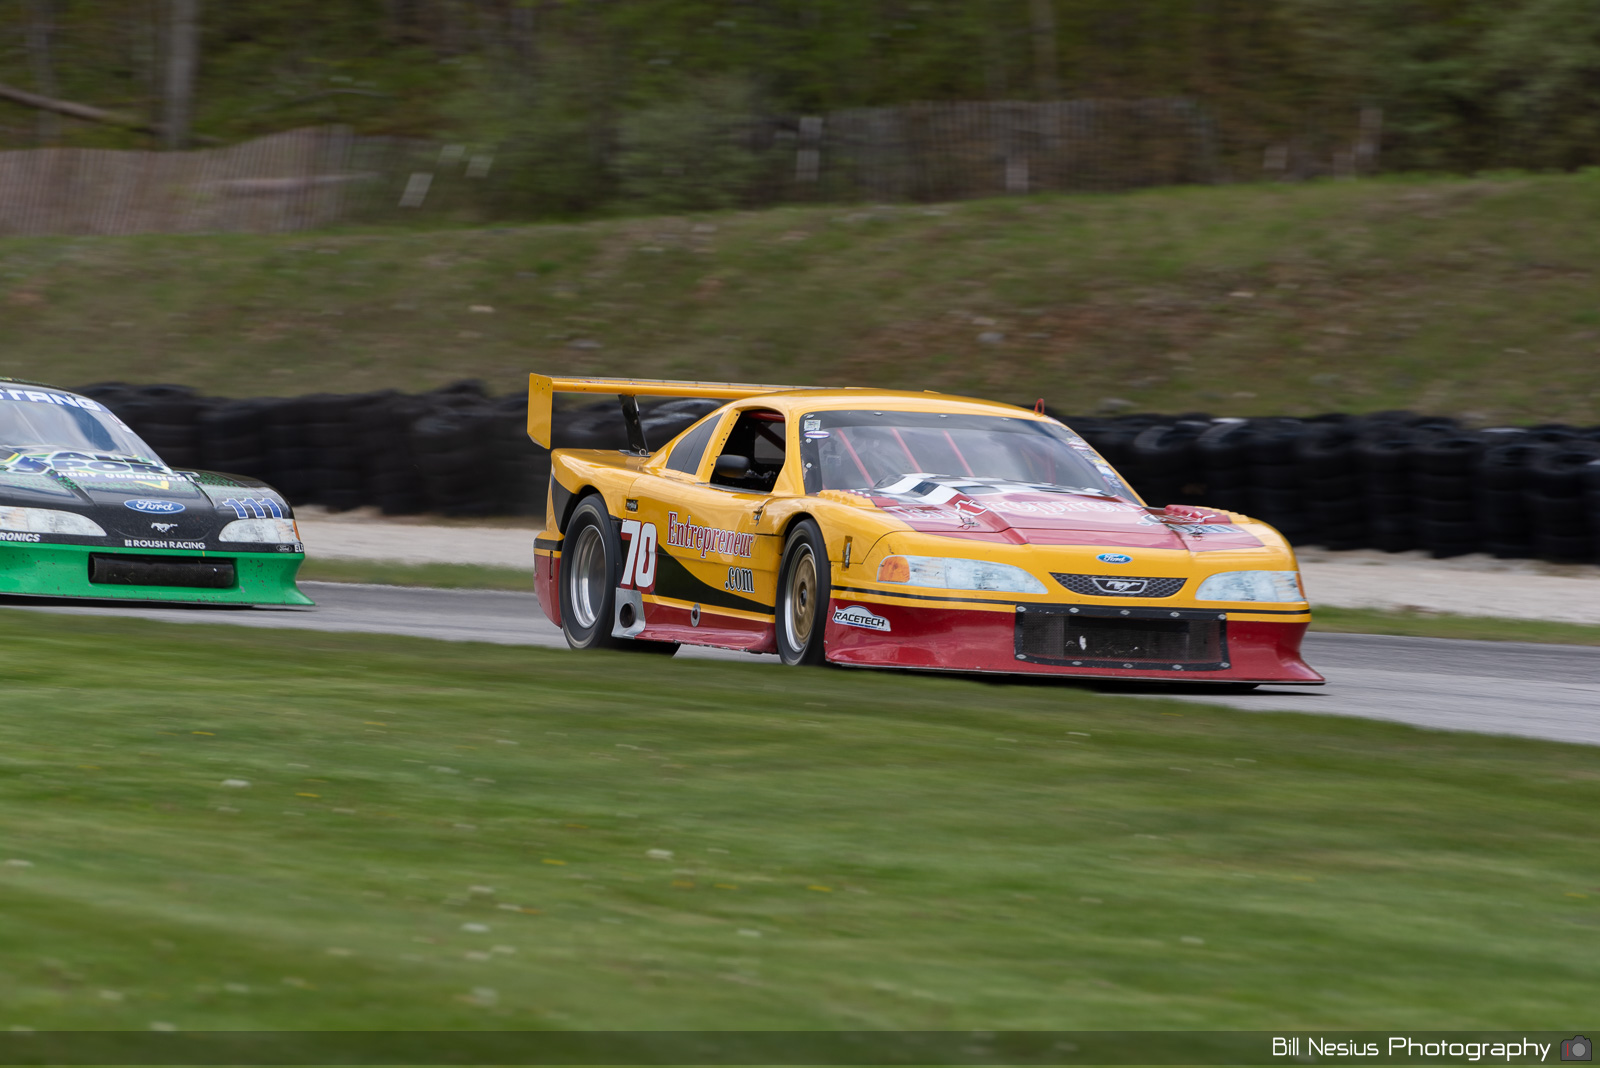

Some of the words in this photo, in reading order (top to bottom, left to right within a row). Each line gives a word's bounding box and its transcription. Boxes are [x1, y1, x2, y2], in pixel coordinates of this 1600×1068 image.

[135, 500, 175, 511] Ford
[222, 498, 283, 518] 111
[0, 531, 41, 543] RONICS
[667, 511, 754, 559] Entrepreneur
[133, 539, 168, 548] ROUSH
[169, 541, 206, 550] RACING
[620, 518, 658, 593] 70
[724, 566, 755, 593] .com
[834, 611, 885, 627] RACETECH
